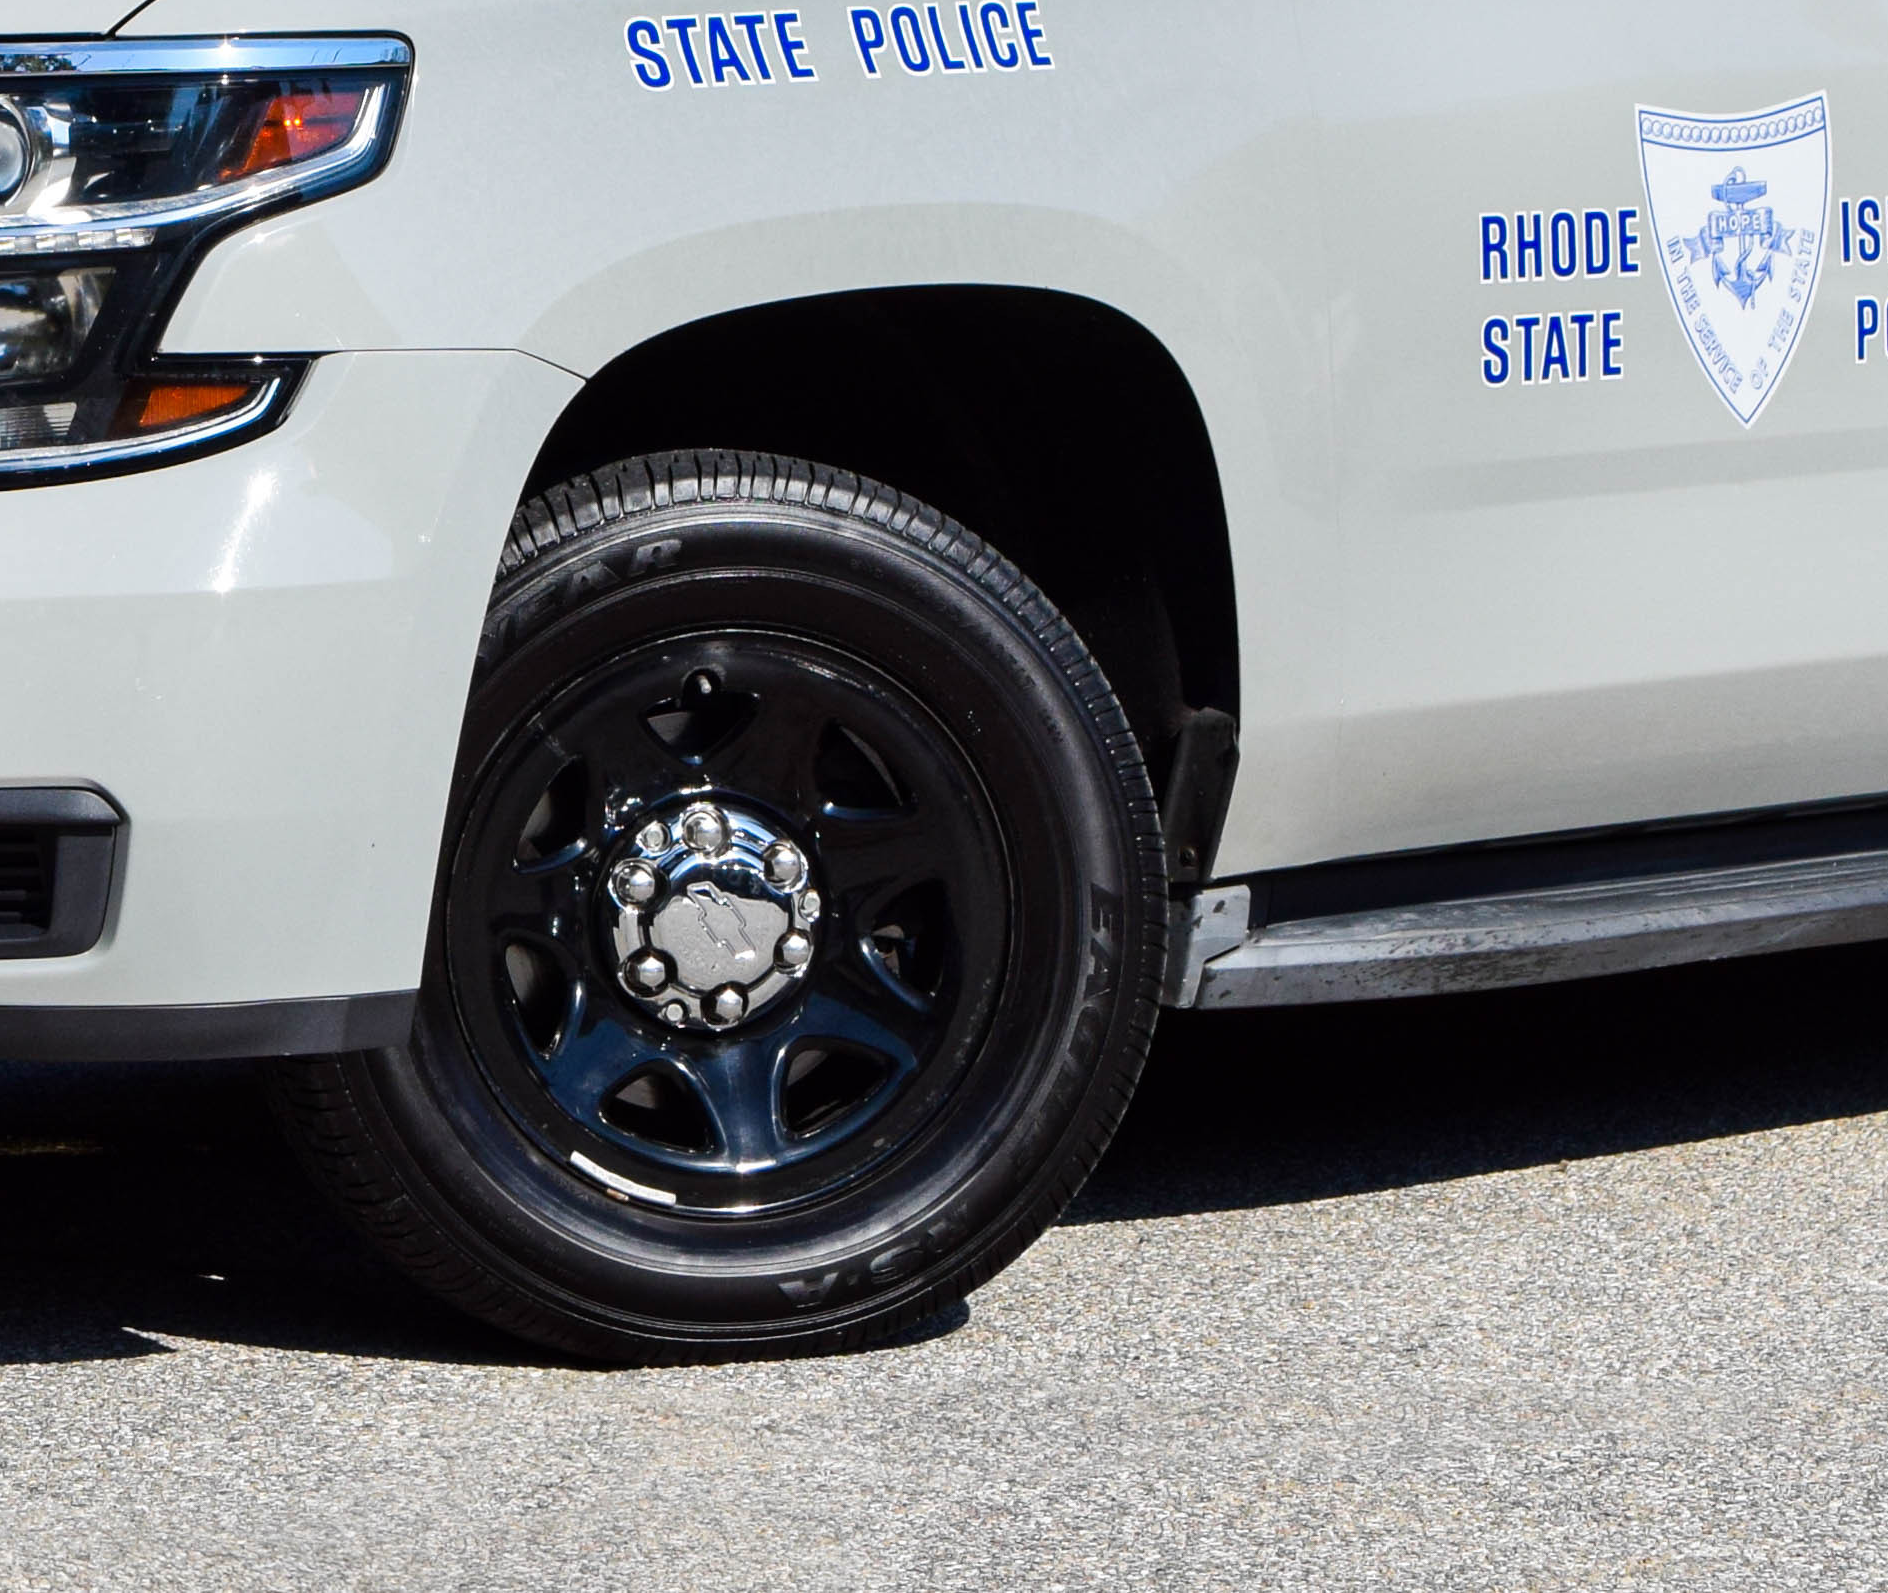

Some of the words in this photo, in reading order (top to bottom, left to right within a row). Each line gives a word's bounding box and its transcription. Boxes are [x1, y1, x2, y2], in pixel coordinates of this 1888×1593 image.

[626, 11, 815, 89] STATE
[849, 0, 1052, 77] POLICE
[1481, 209, 1639, 281] RHODE
[1717, 213, 1762, 232] HOPE
[1666, 235, 1684, 264] IN
[1677, 266, 1700, 315] THE
[1695, 313, 1744, 394] SERVICE
[1750, 357, 1768, 390] OF
[1768, 308, 1794, 352] THE
[1789, 228, 1815, 303] STATE
[1482, 313, 1622, 385] STATE
